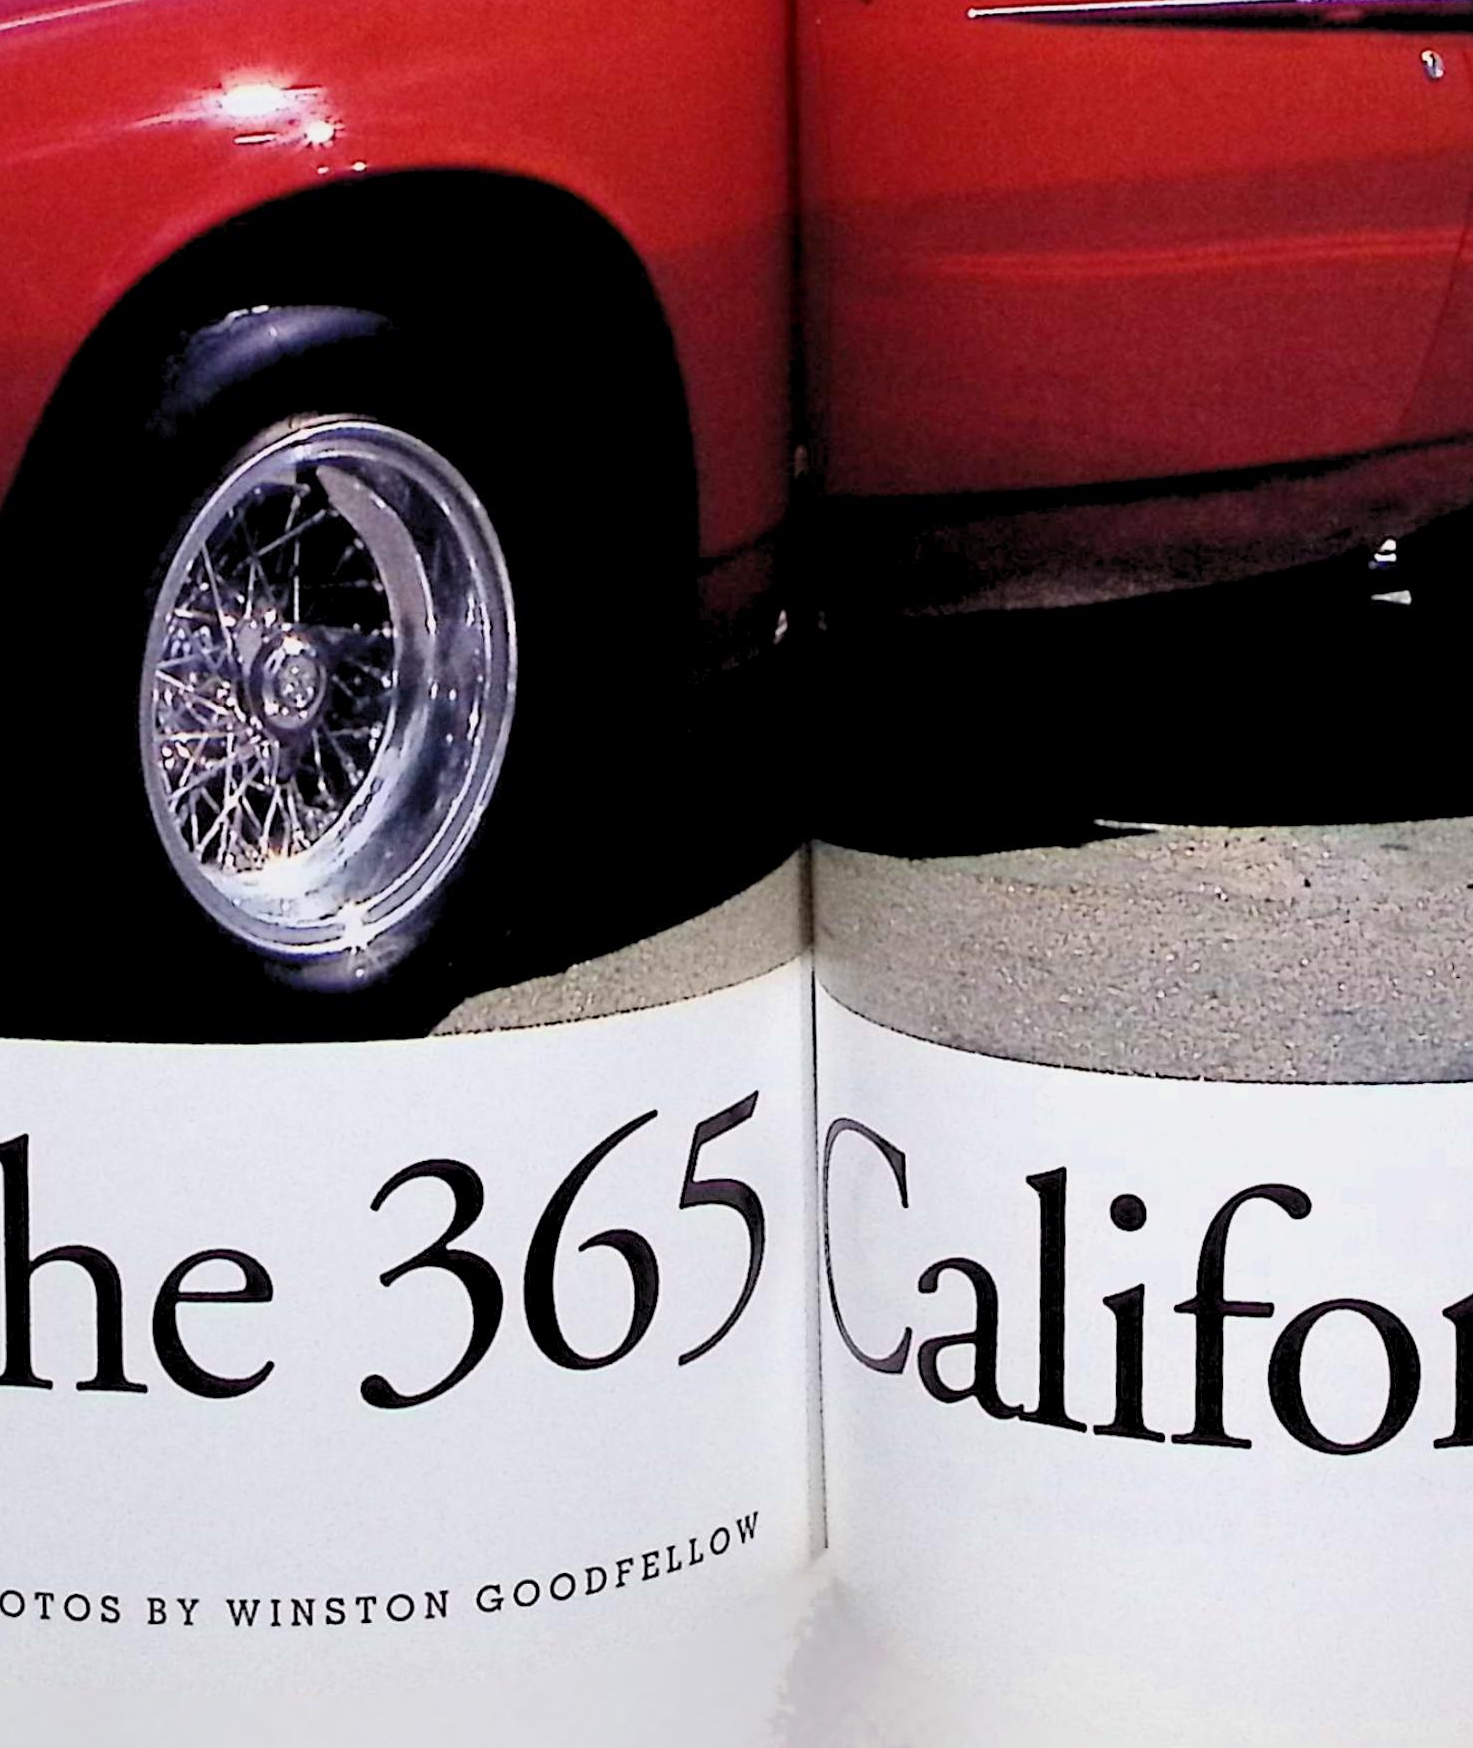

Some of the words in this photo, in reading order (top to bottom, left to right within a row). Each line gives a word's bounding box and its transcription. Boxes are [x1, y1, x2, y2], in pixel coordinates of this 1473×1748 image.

[360, 1090, 765, 1409] 365
[147, 1598, 199, 1625] BY
[226, 1590, 448, 1627] WINSTON
[476, 1511, 758, 1612] GOODFELLOW
